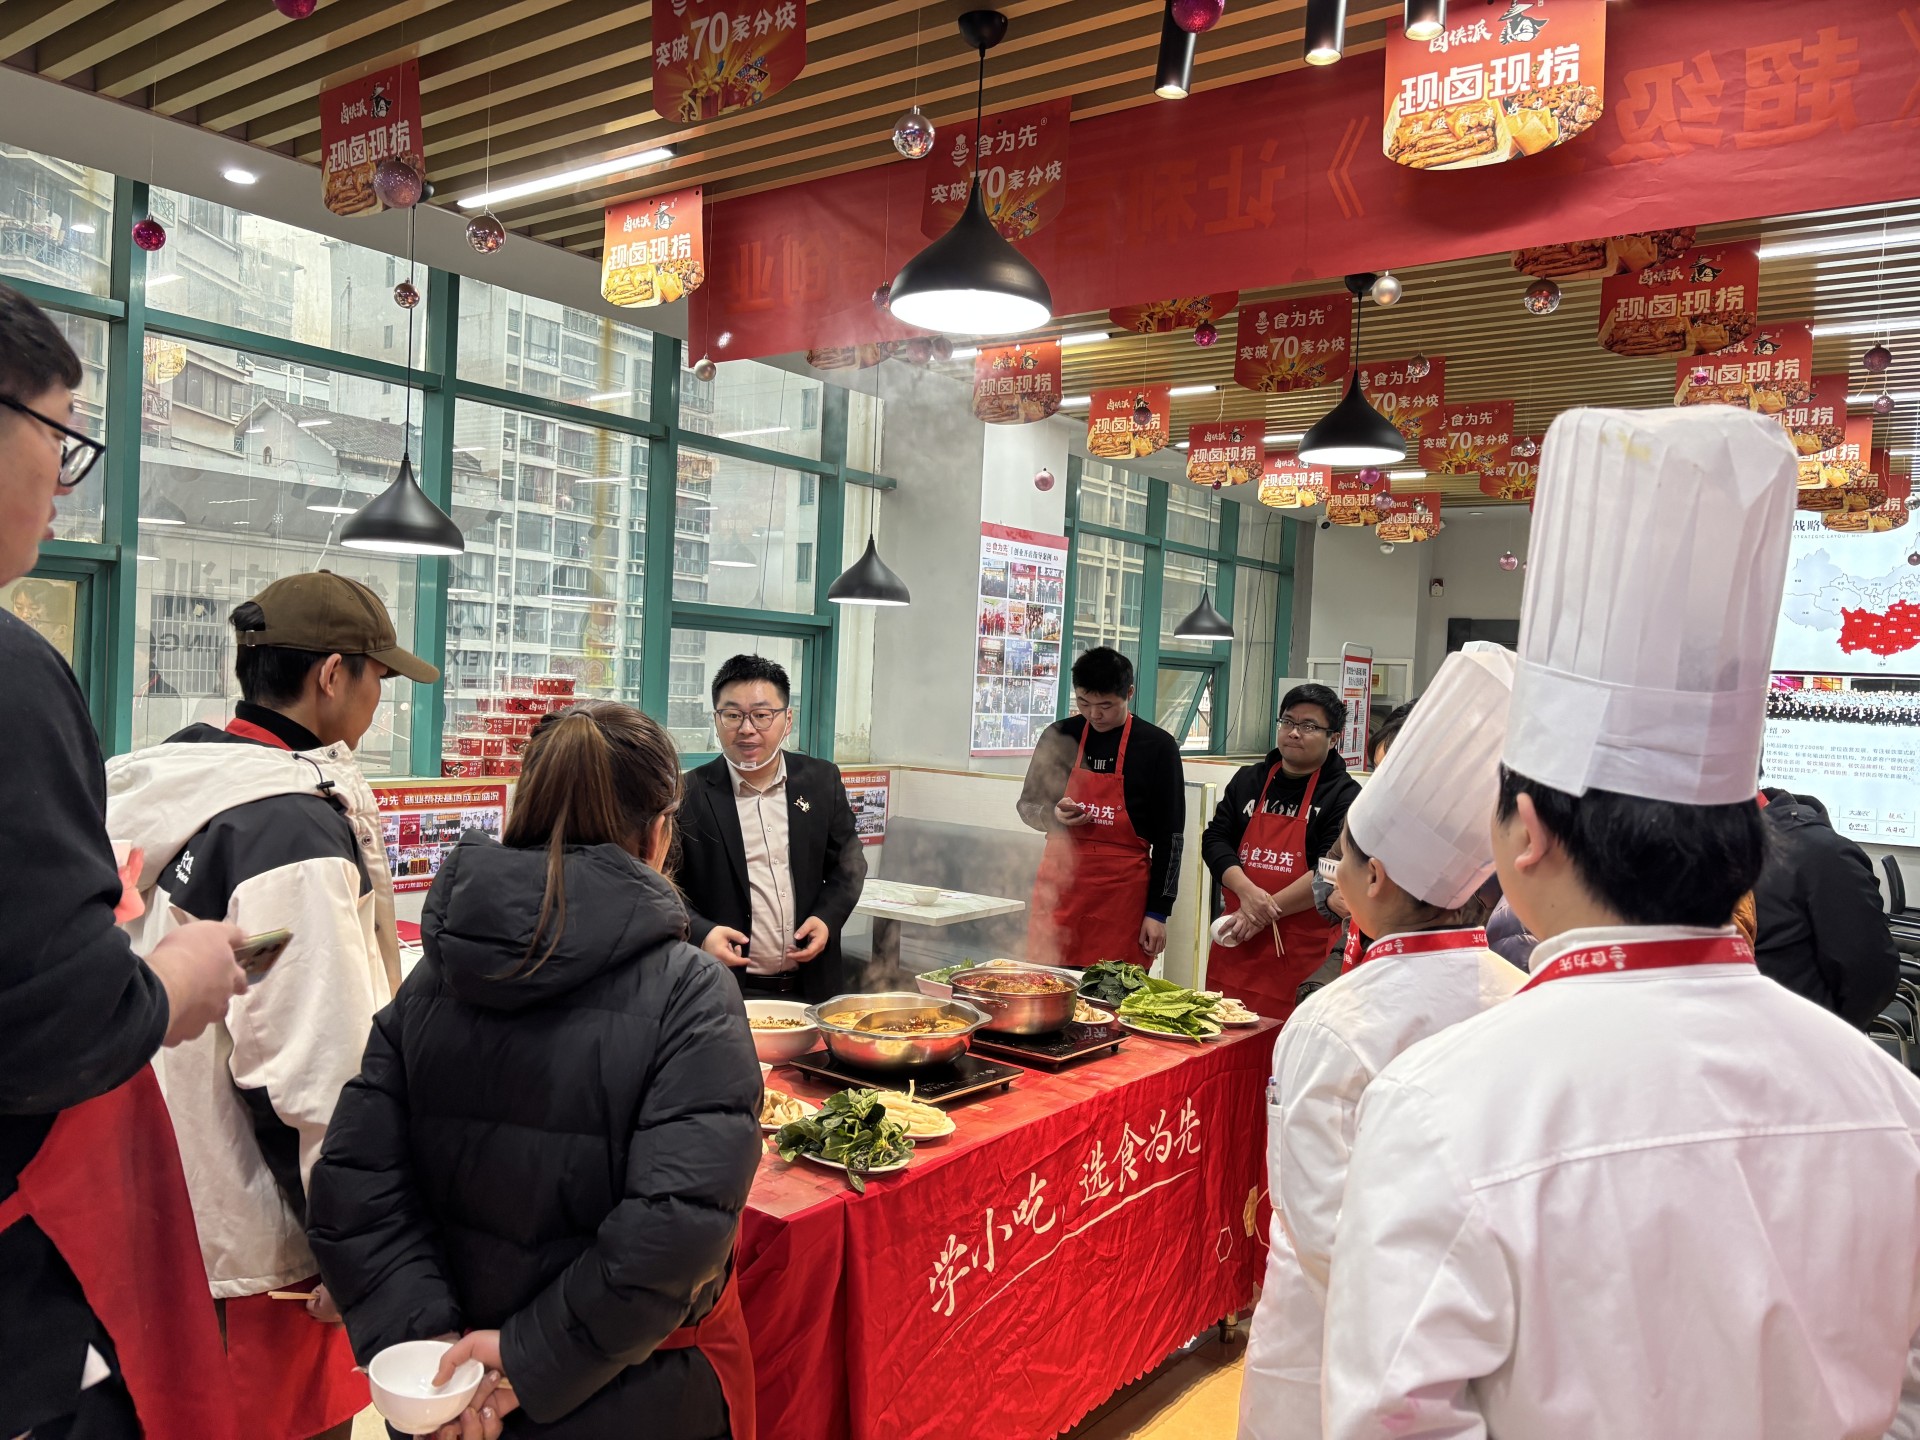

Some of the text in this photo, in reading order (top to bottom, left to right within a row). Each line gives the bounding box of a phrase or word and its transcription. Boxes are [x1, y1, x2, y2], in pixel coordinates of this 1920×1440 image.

[655, 2, 798, 70] 突破70家分校
[1399, 43, 1580, 117] 现卤现捞
[329, 120, 411, 173] 现卤现捞
[975, 124, 1038, 158] 食为先
[609, 233, 691, 271] 现卤现捞
[1615, 284, 1744, 322] 现卤现捞
[1273, 308, 1325, 330] 食为先
[1240, 336, 1345, 361] 突破70家分校
[979, 373, 1052, 397] 现卤现捞
[1451, 412, 1493, 427] 食为先
[1423, 431, 1510, 449] 突破70家分校
[1193, 446, 1257, 463] 现卤现捞
[1264, 472, 1324, 487] 现卤现捞
[375, 794, 399, 807] 为先
[1251, 847, 1294, 867] 食为先
[1559, 951, 1608, 972] 食为先
[1078, 1097, 1201, 1206] 选食为先
